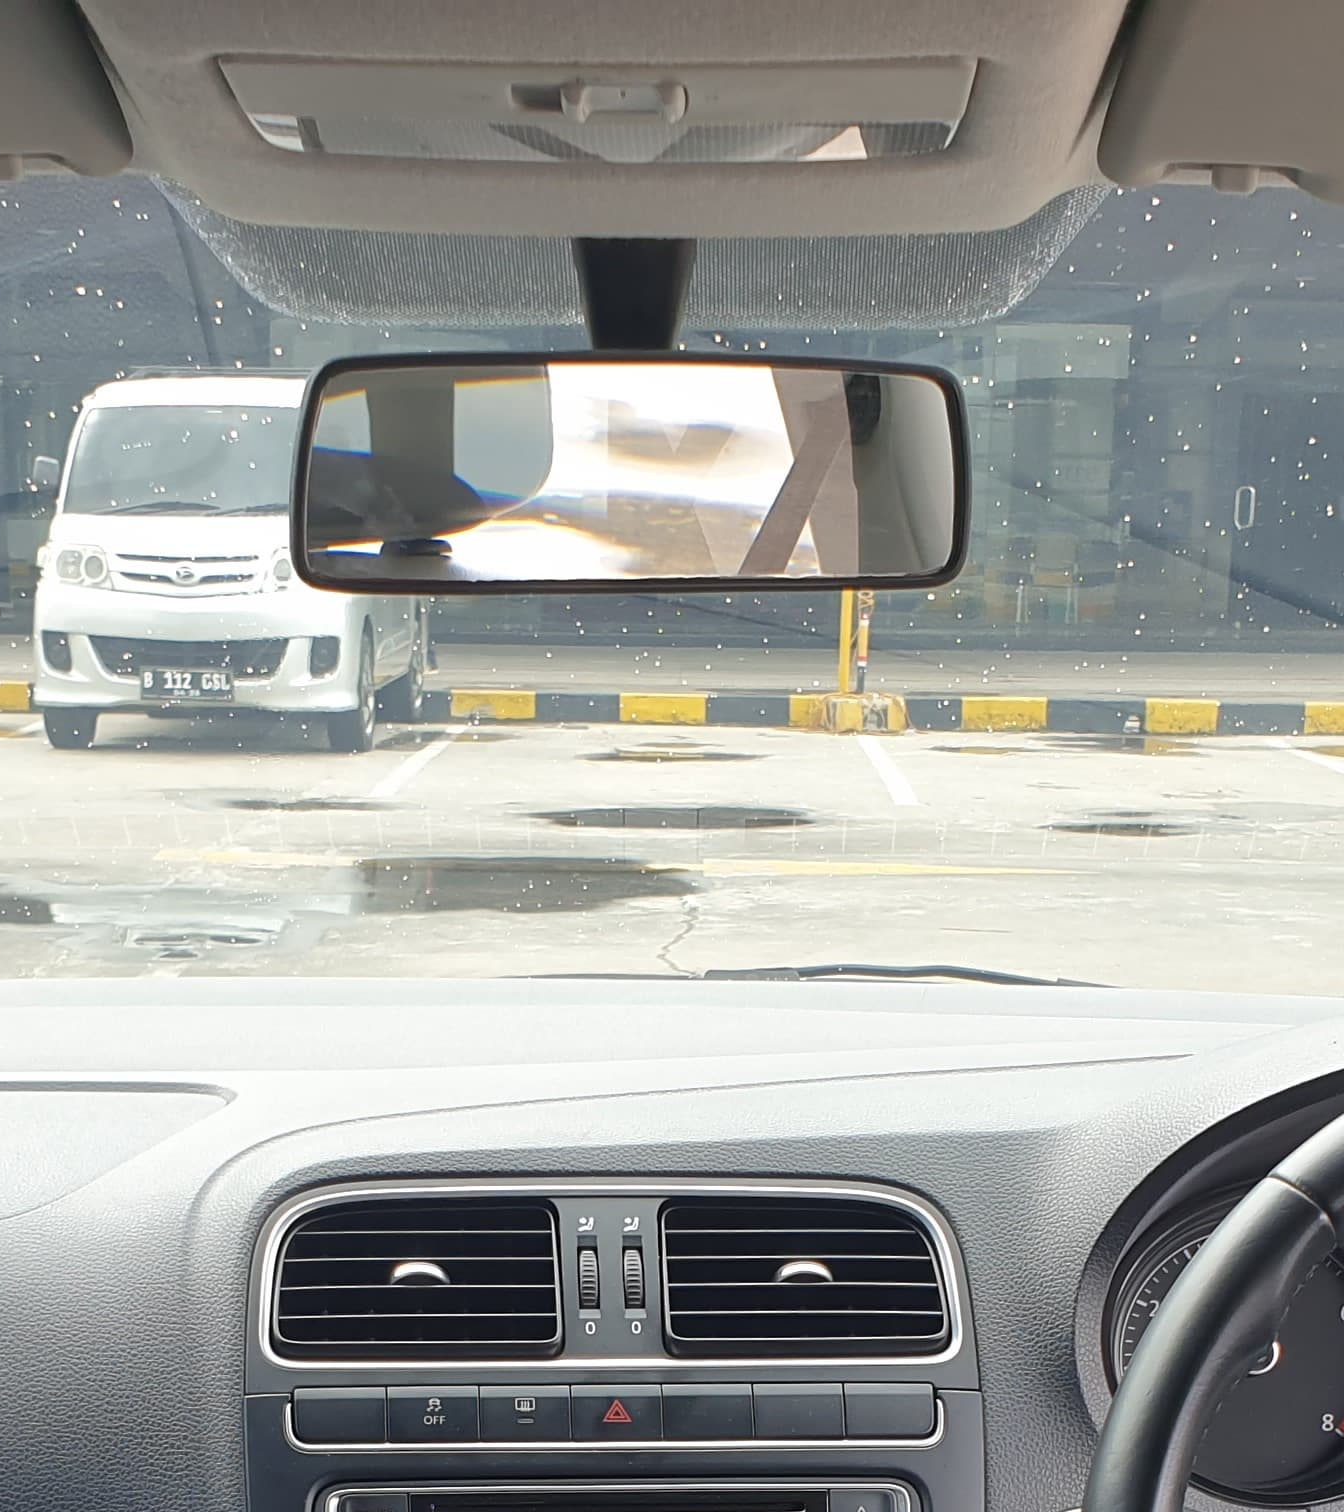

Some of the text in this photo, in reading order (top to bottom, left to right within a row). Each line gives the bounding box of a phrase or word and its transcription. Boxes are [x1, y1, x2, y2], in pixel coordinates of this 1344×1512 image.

[143, 671, 154, 689] B
[163, 671, 193, 690] 112
[423, 1415, 447, 1425] OFF
[1320, 1413, 1335, 1432] 8
